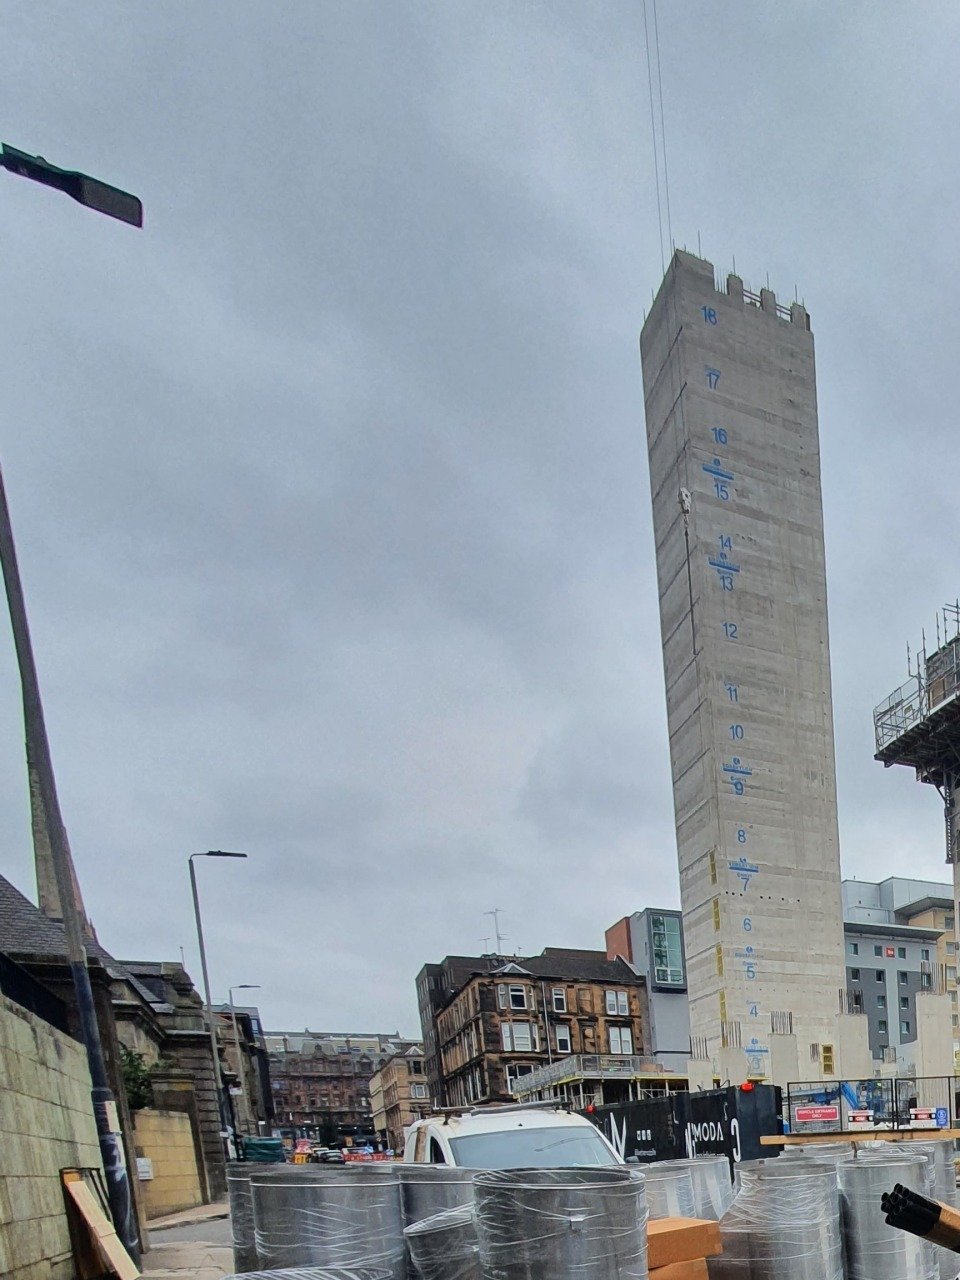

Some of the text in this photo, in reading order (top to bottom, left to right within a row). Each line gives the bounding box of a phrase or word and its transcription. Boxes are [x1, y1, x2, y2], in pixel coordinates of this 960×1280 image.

[701, 306, 718, 326] 18
[706, 372, 720, 390] 17
[711, 427, 728, 445] 16
[714, 483, 729, 501] 15
[719, 534, 732, 551] 14
[720, 575, 734, 592] 13
[723, 622, 738, 639] 12
[727, 686, 738, 702] 11
[729, 724, 744, 740] 10
[734, 780, 745, 796] 9
[737, 829, 747, 844] 8
[740, 877, 750, 892] 7
[743, 917, 752, 932] 6
[746, 965, 756, 980] 5
[749, 1004, 759, 1018] 4
